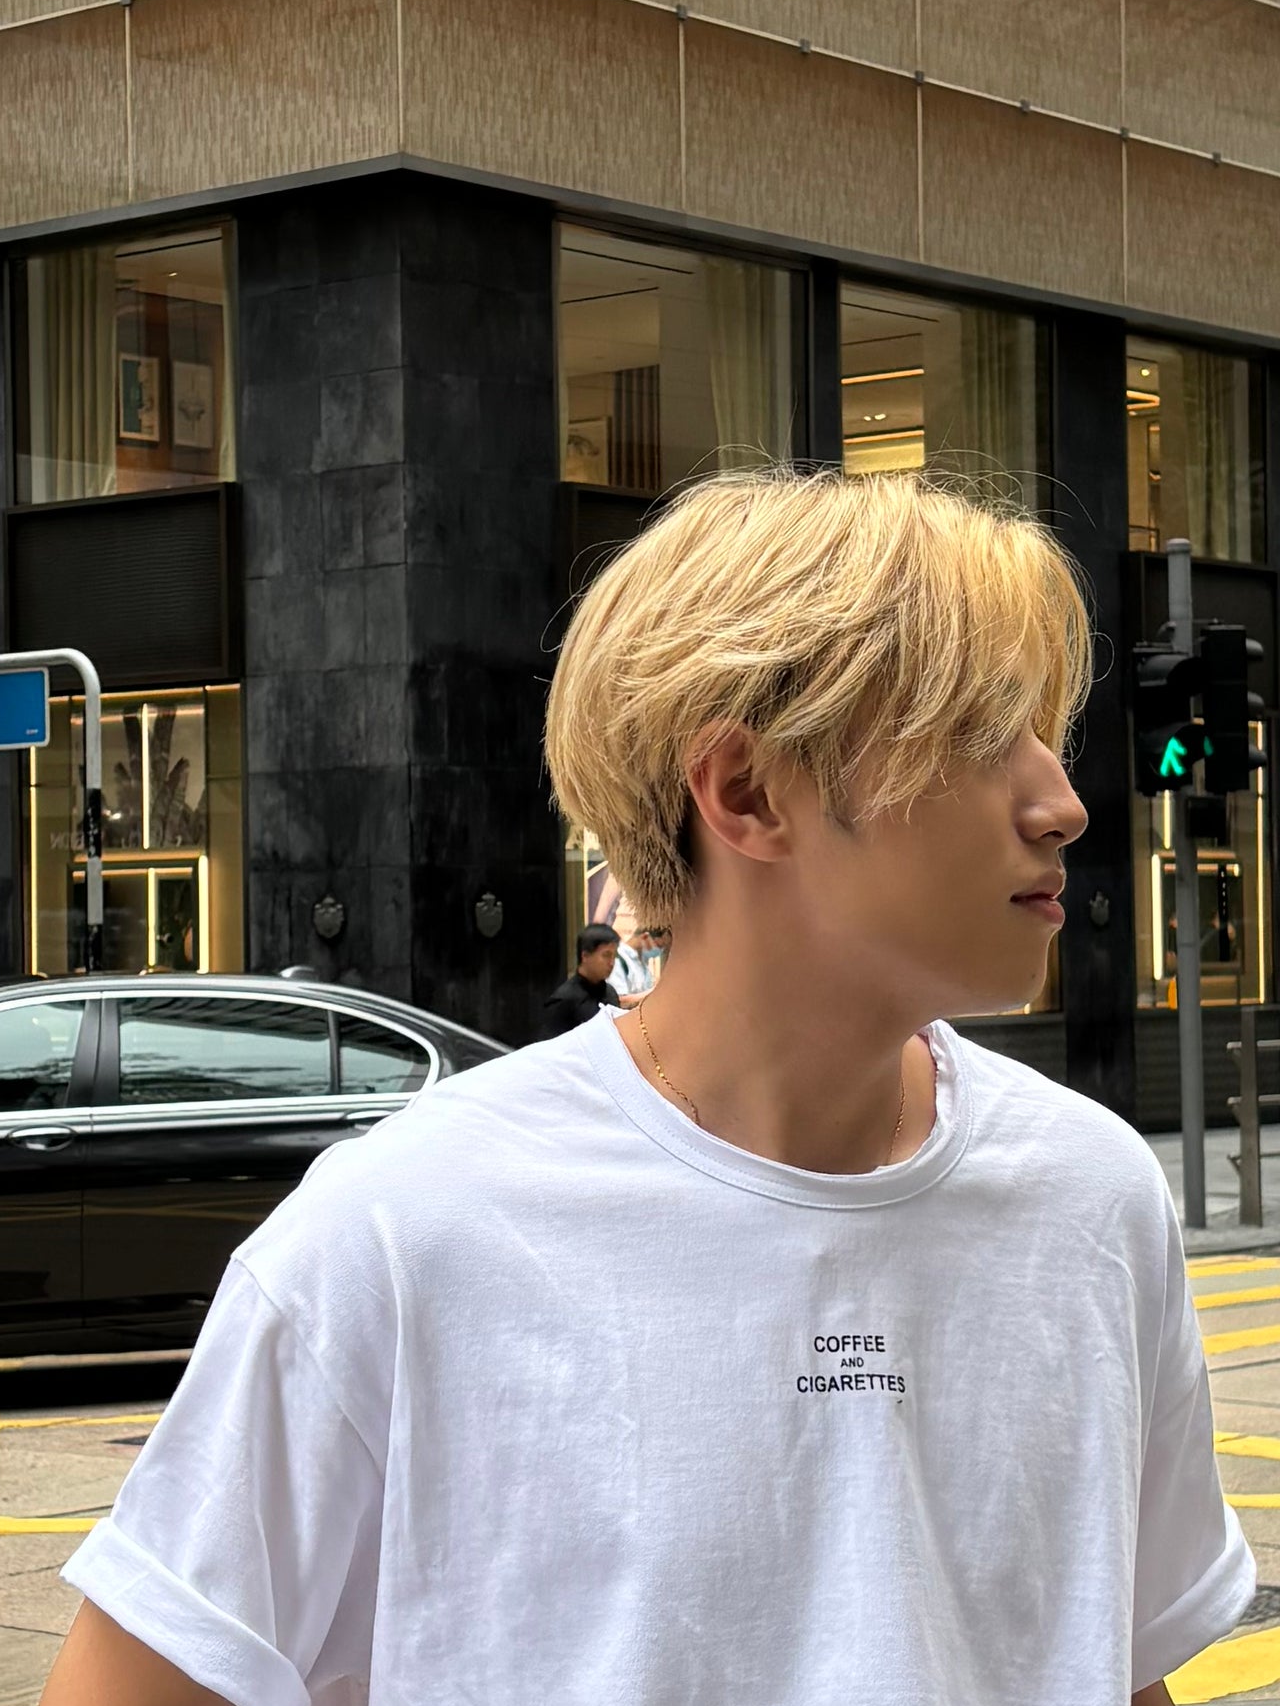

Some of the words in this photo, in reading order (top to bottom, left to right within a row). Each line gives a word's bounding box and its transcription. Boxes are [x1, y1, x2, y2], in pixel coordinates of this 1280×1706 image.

[814, 1335, 886, 1353] COFFEE
[840, 1357, 864, 1368] AND
[796, 1373, 906, 1393] CIGARETTES
